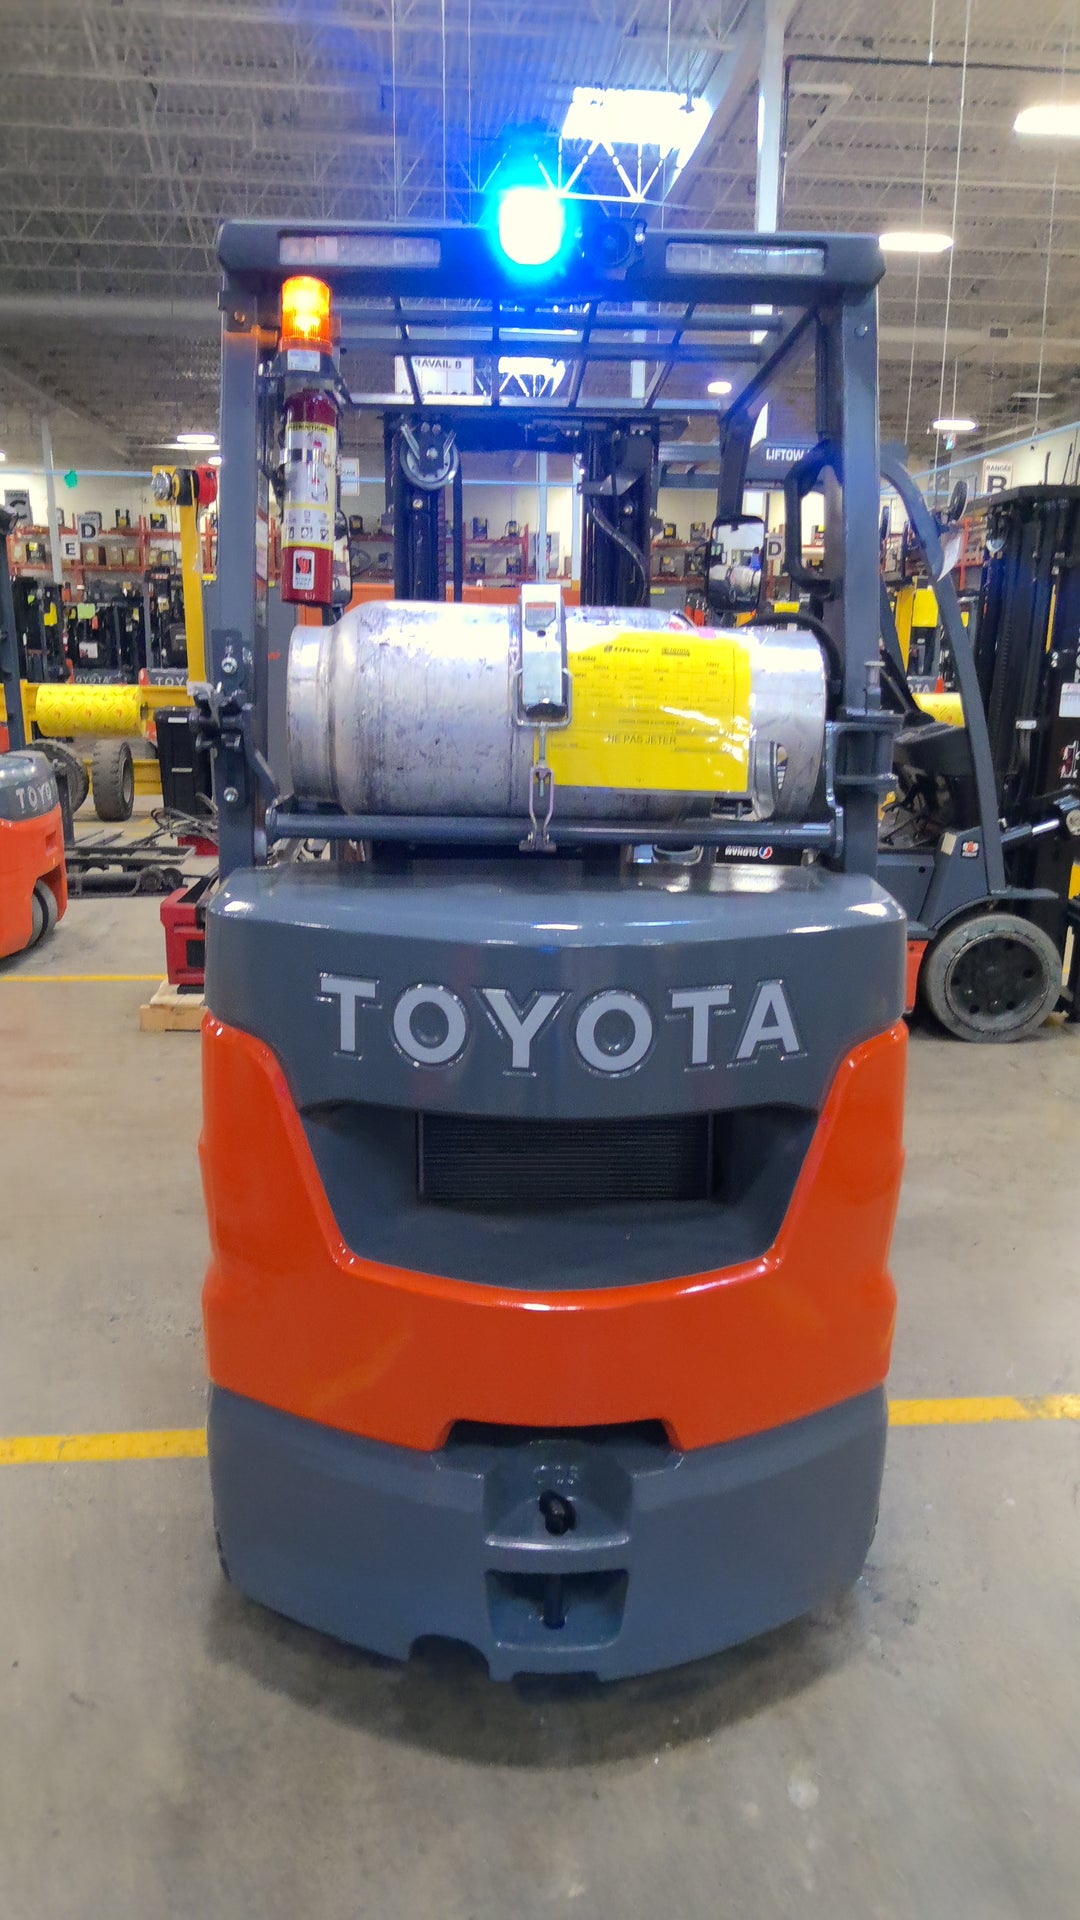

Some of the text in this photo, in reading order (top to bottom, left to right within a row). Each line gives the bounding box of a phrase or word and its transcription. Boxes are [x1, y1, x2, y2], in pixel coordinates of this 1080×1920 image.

[412, 358, 451, 369] RAVAIL
[765, 447, 804, 461] LIFTOW
[80, 523, 96, 539] D
[65, 542, 76, 556] E
[767, 541, 782, 556] D
[75, 673, 112, 685] OYOTA
[154, 675, 186, 688] TOY
[623, 734, 643, 745] PAS
[645, 735, 678, 746] JETER
[317, 974, 804, 1075] TOYOTA
